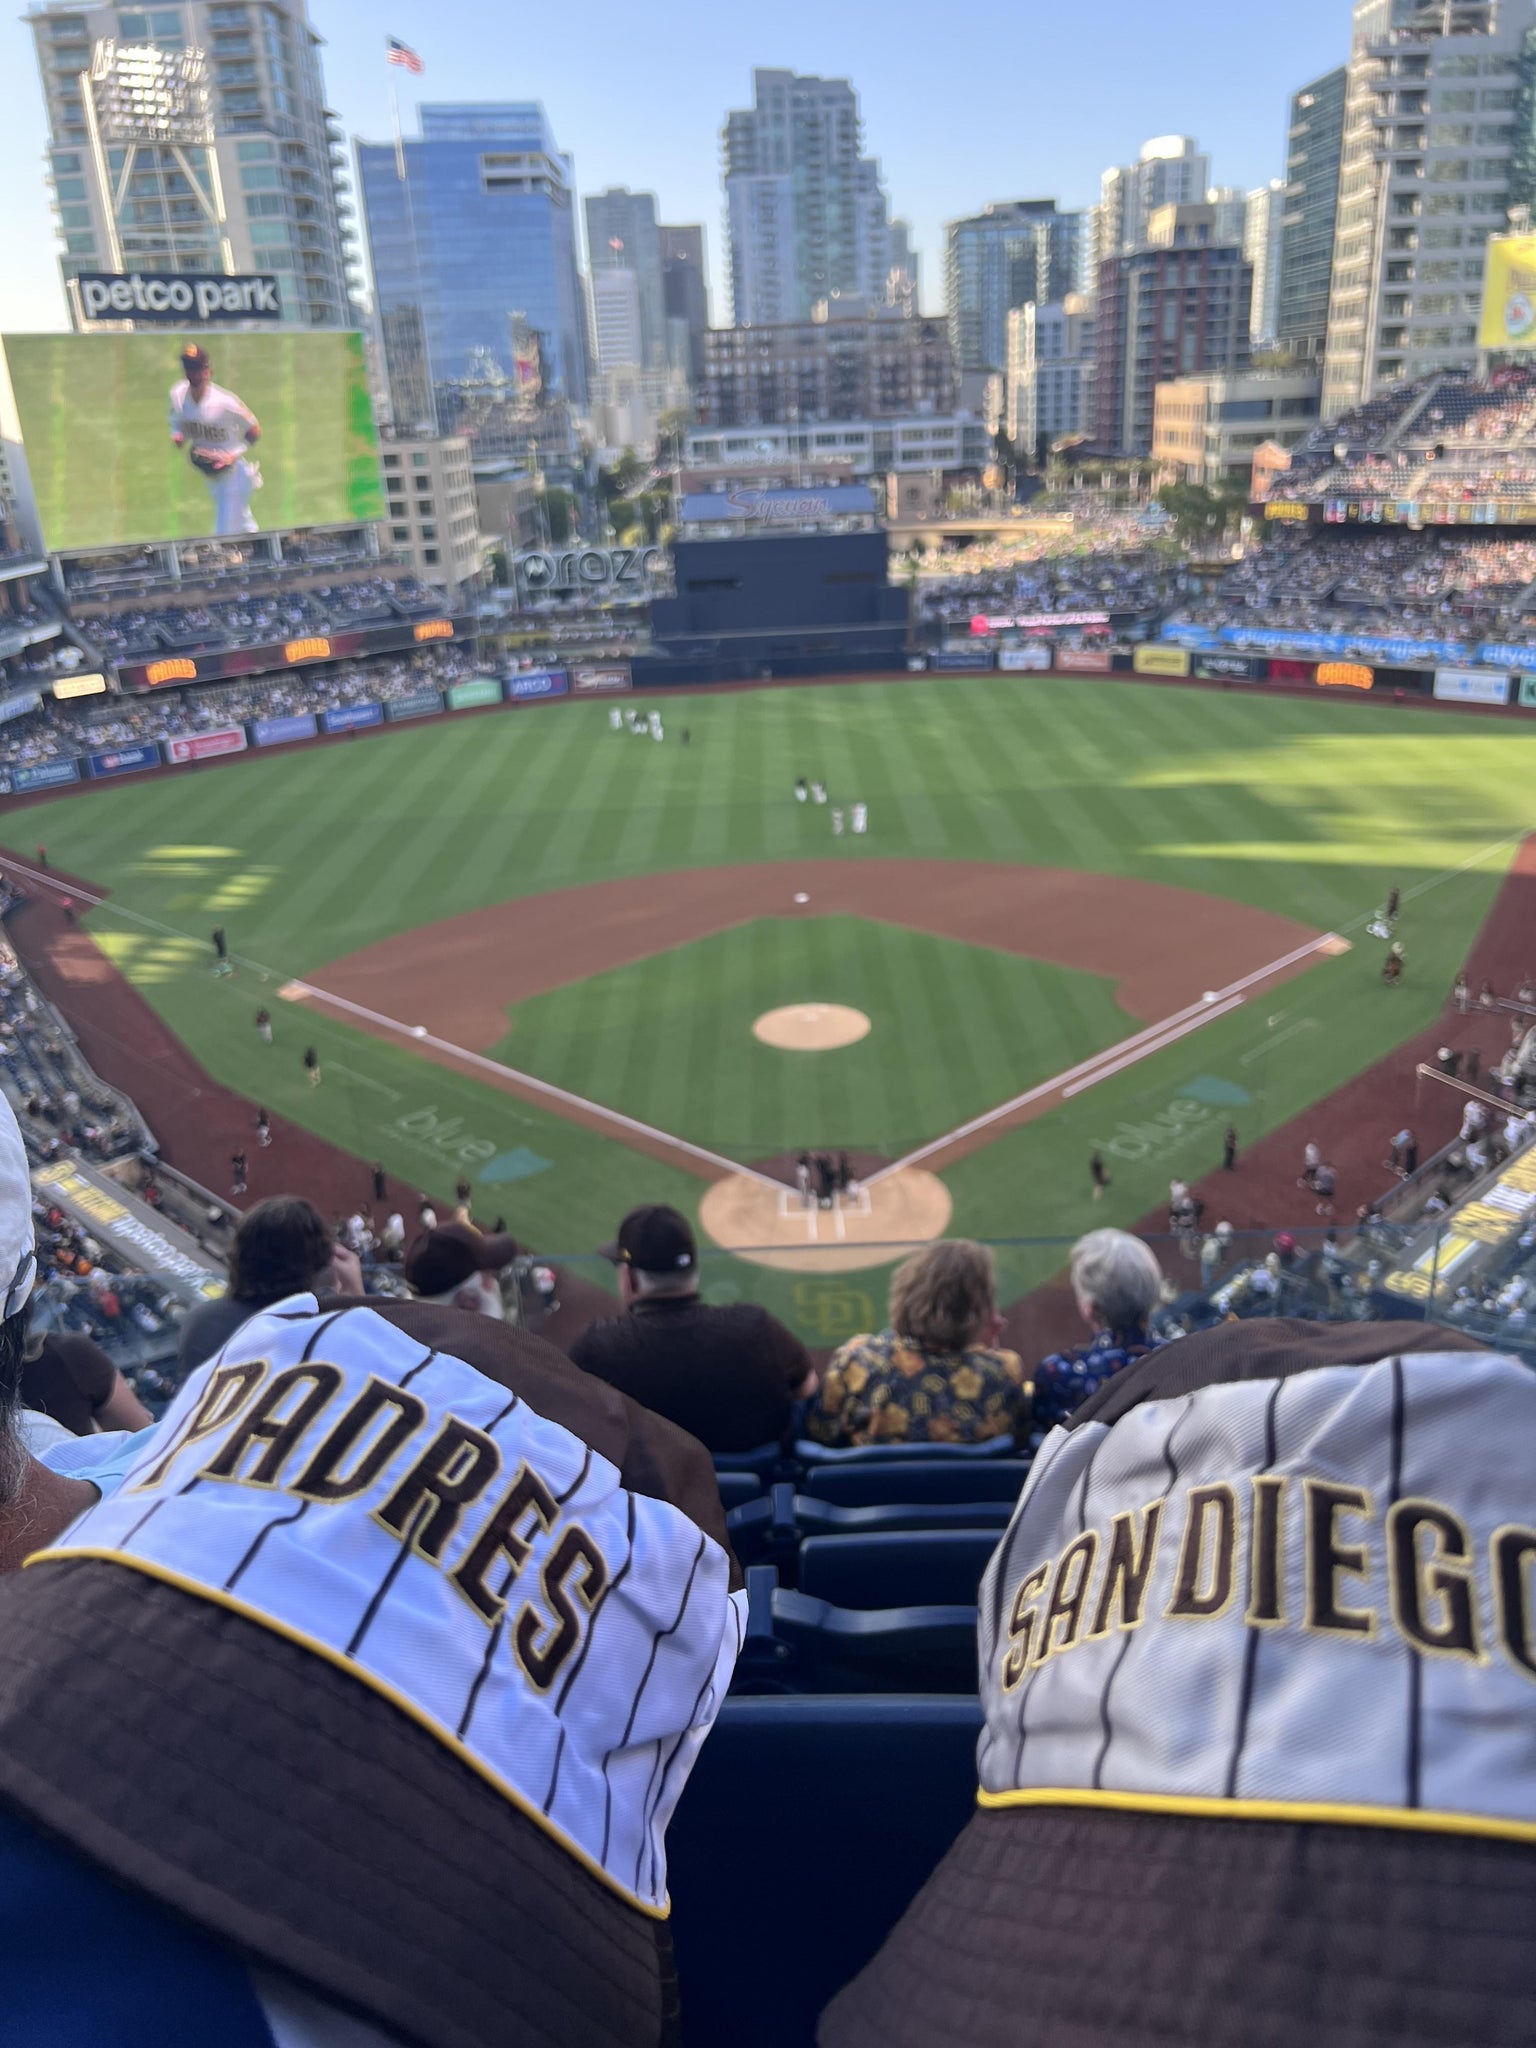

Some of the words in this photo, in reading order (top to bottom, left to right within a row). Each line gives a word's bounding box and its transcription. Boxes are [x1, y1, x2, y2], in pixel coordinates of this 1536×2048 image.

[81, 273, 193, 319] petco
[195, 277, 280, 320] park
[726, 487, 832, 526] Sycuan
[513, 677, 552, 693] ARCO
[124, 1357, 609, 1696] PADRES
[1001, 1496, 1166, 1694] SAN
